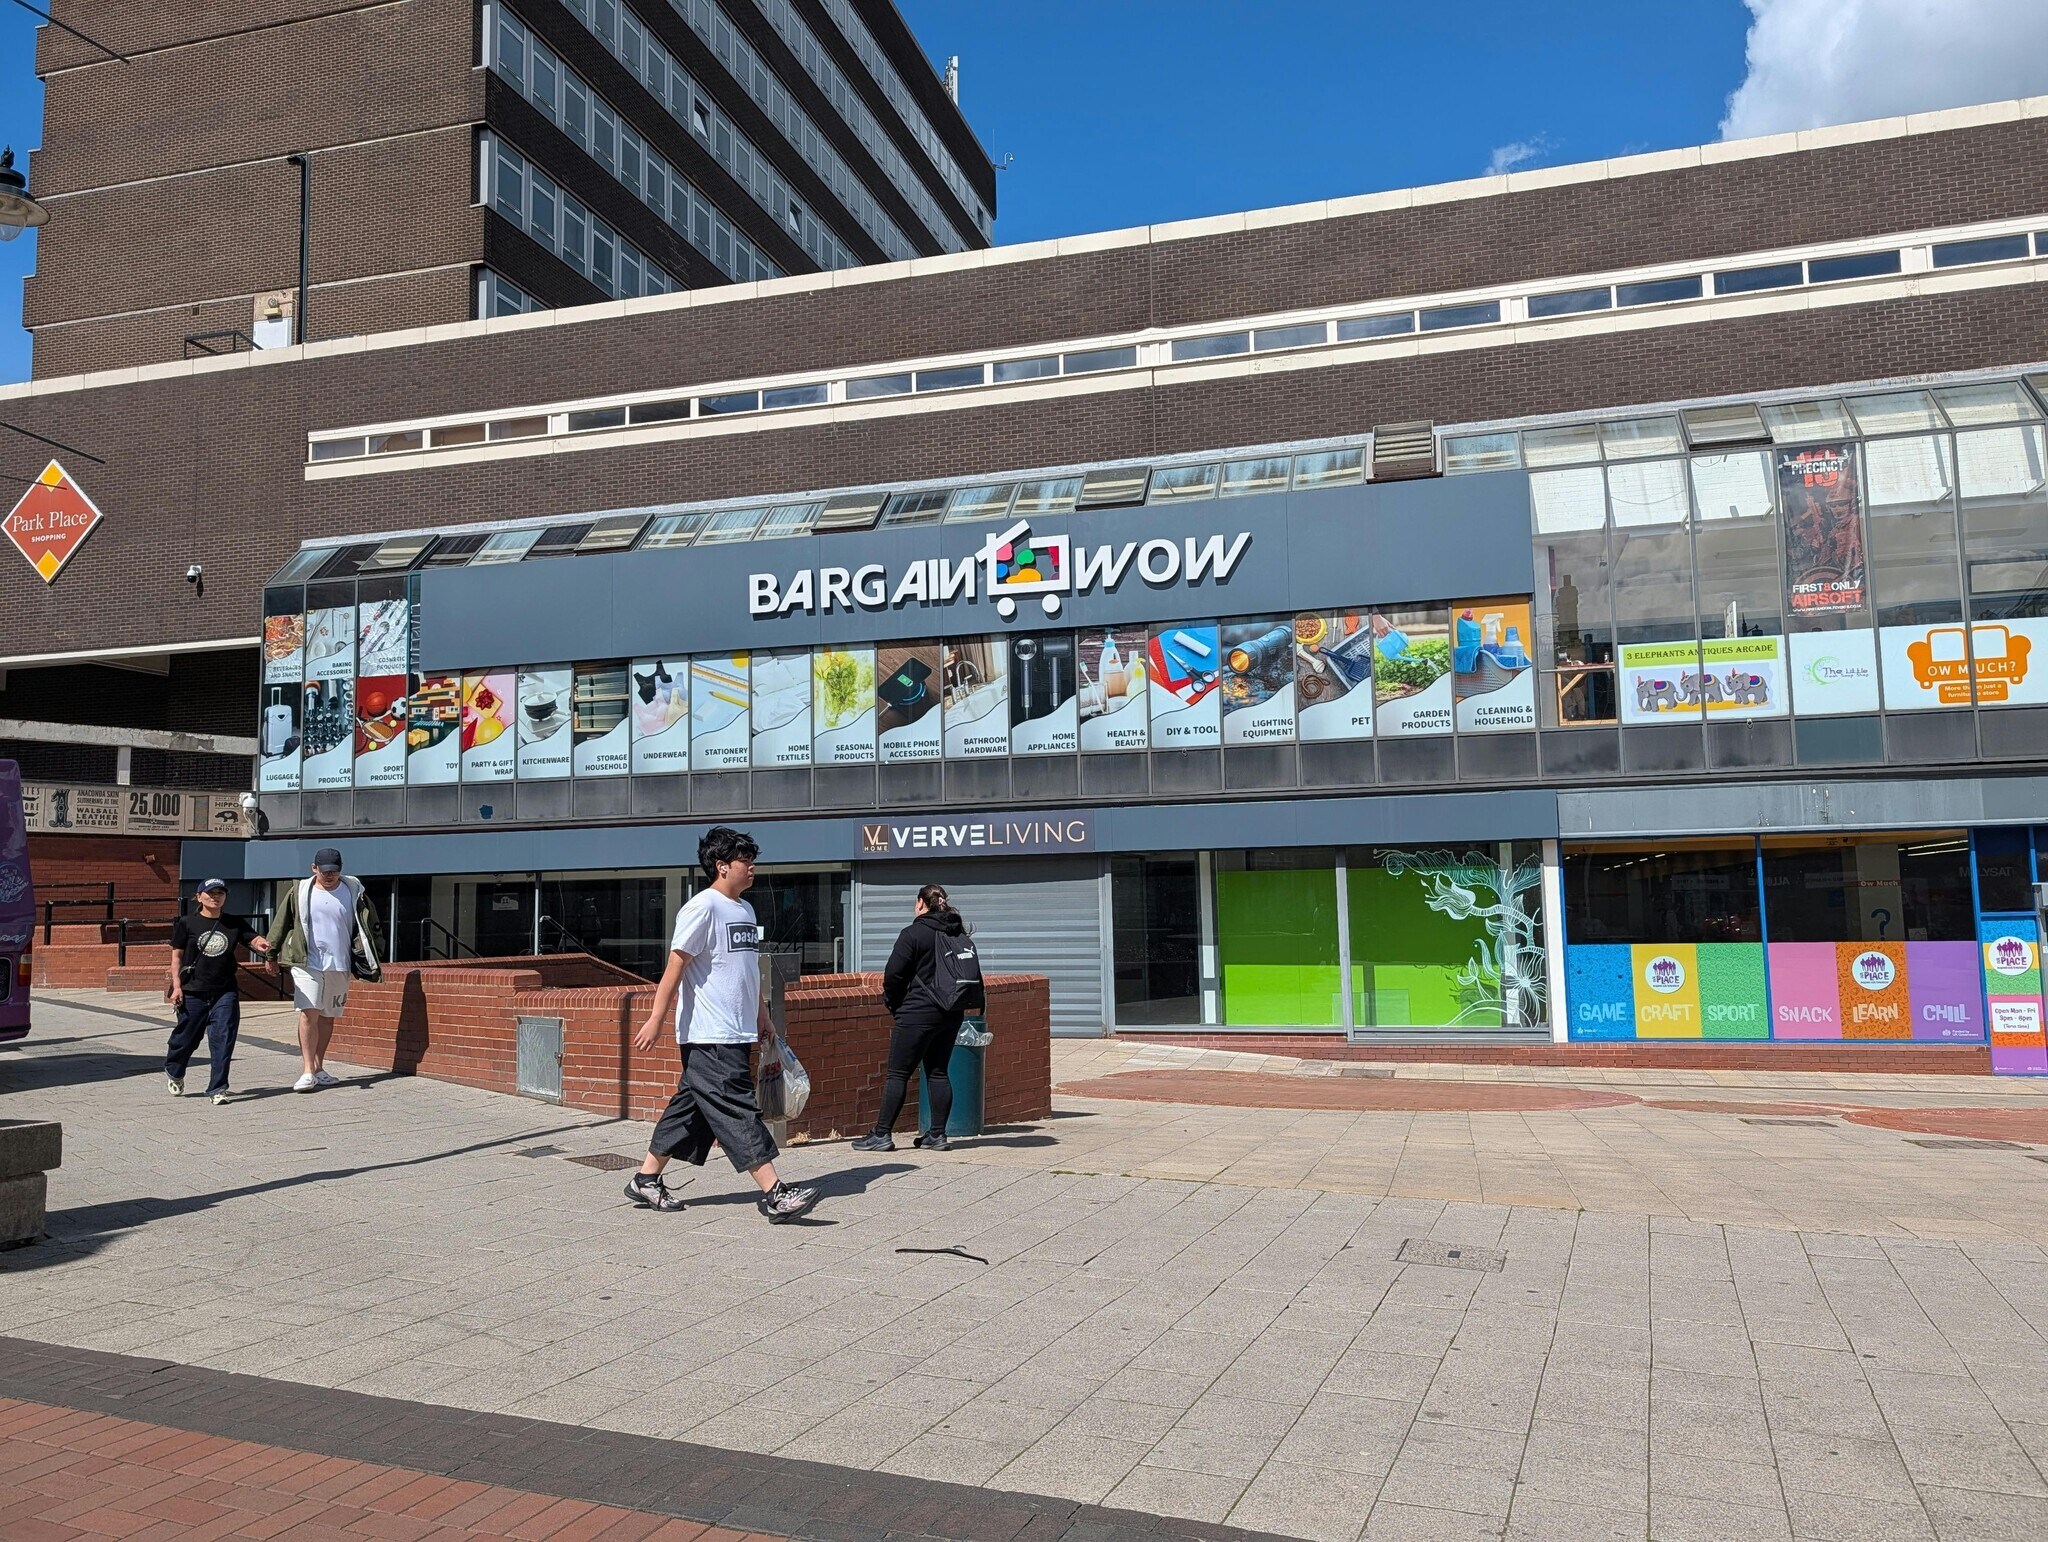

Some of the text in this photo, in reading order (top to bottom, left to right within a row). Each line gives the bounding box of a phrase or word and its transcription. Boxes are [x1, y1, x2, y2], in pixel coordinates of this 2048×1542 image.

[1792, 460, 1844, 475] PRECINCT
[12, 511, 88, 532] Park Place
[31, 533, 66, 542] SHOPPING
[749, 532, 1252, 615] BARGAIN WOW
[1792, 590, 1862, 607] AIRSOFT
[1635, 649, 1685, 659] ELEPHANTS
[1688, 646, 1733, 656] ANTIQUES
[1736, 644, 1773, 653] ARCADE
[1928, 661, 2016, 676] OW MUCH?
[1413, 710, 1450, 718] GARDEN
[1476, 706, 1524, 715] CLEANING
[1252, 719, 1293, 727] LIGHTING
[1352, 716, 1370, 725] PET
[1402, 720, 1451, 729] PRODUCTS
[1475, 716, 1533, 726] HOUSEHOLD
[1166, 728, 1181, 736] DIY
[1193, 726, 1218, 734] TOOL
[1243, 728, 1293, 738] EQUIPMENT
[964, 736, 1007, 745] BATHROOM
[836, 743, 874, 751] SEASONAL
[964, 746, 1007, 754] HARDWARE
[1028, 742, 1076, 750] APPLIANCES
[643, 751, 687, 759] UNDERWEAR
[705, 748, 748, 756] STATIONERY
[834, 752, 874, 760] PRODUCTS
[889, 750, 940, 758] ACCESSORIES
[522, 757, 570, 765] KITCHENWARE
[585, 763, 627, 771] HOUSEHOLD
[130, 793, 180, 817] 25,000
[733, 929, 759, 943] oasis
[2001, 957, 2027, 966] PLACE
[1657, 976, 1680, 984] PLACE
[1865, 972, 1889, 980] PLACE
[1579, 1002, 1627, 1023] GAME
[1641, 1004, 1693, 1021] CRAFT
[1707, 1004, 1760, 1021] SPORT
[1778, 1005, 1832, 1023] SNACK
[1853, 1003, 1899, 1023] LEARN
[1922, 1004, 1970, 1023] CHILL
